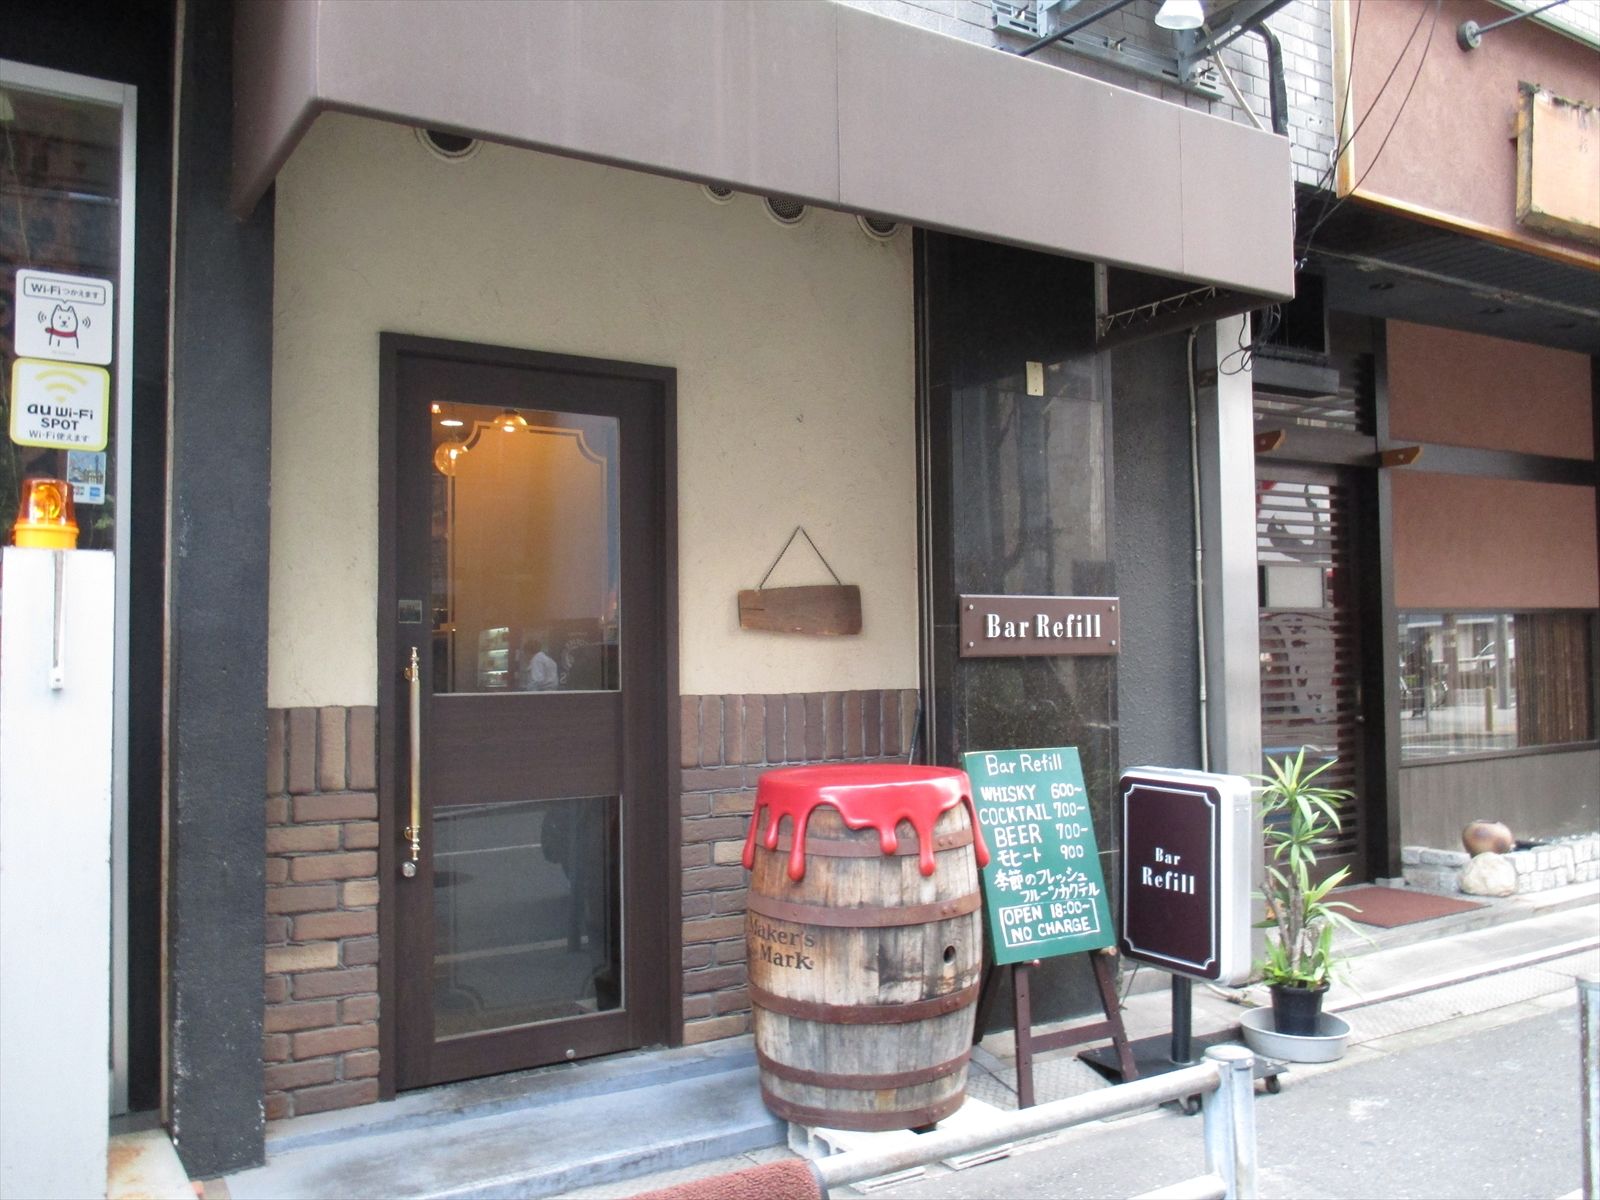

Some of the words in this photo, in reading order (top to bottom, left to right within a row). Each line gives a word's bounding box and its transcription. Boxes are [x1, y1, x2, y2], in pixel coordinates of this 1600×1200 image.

[27, 403, 51, 416] au
[41, 417, 79, 431] SPOT
[986, 613, 1029, 638] Bar
[1036, 613, 1101, 638] Refill
[985, 754, 1016, 776] Bar
[1020, 753, 1063, 773] Refill
[980, 784, 1036, 803] WHISKY
[979, 803, 1053, 826] COCKTAIL
[994, 823, 1043, 849] BEER
[1060, 844, 1085, 860] 900
[1155, 848, 1181, 865] Bar
[1142, 866, 1196, 896] Refill
[1004, 905, 1043, 927] OPEN
[1010, 926, 1033, 943] NO
[1037, 916, 1092, 937] CHARGE
[760, 943, 813, 970] Mark
